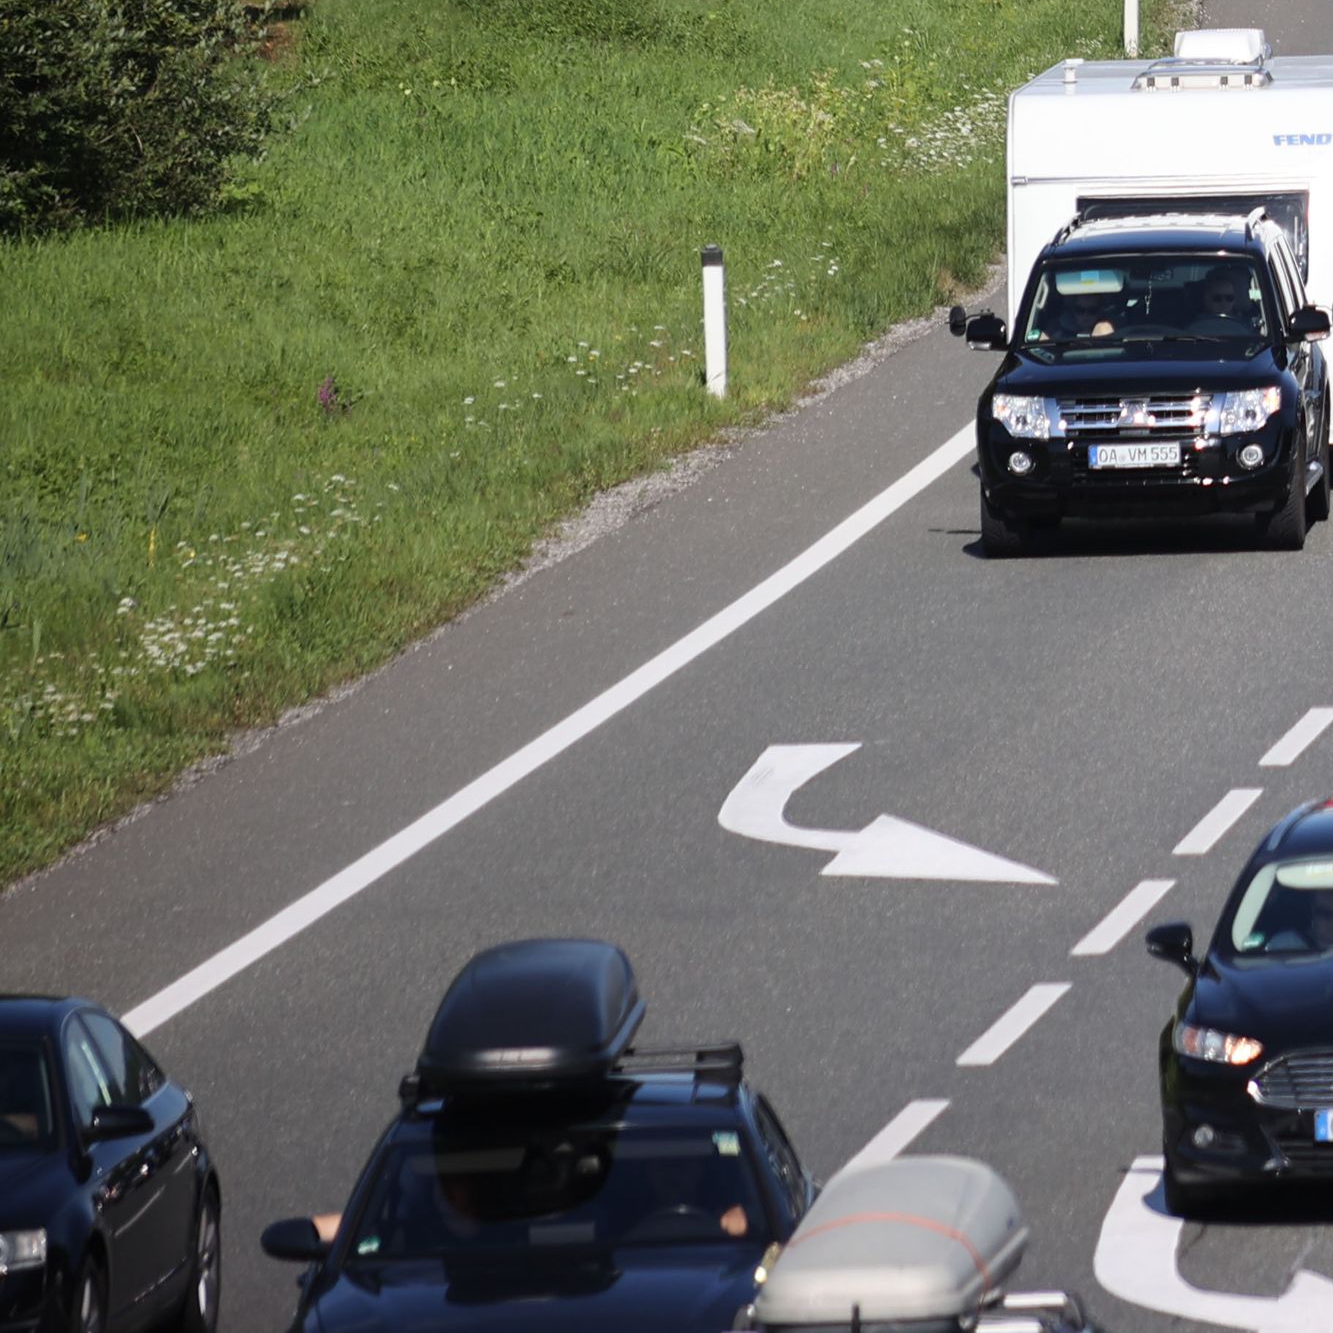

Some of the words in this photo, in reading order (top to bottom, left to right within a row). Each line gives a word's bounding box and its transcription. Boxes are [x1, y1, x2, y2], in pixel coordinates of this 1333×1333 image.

[1099, 448, 1117, 461] OA
[1129, 448, 1147, 460] VM
[1151, 446, 1178, 460] 555
